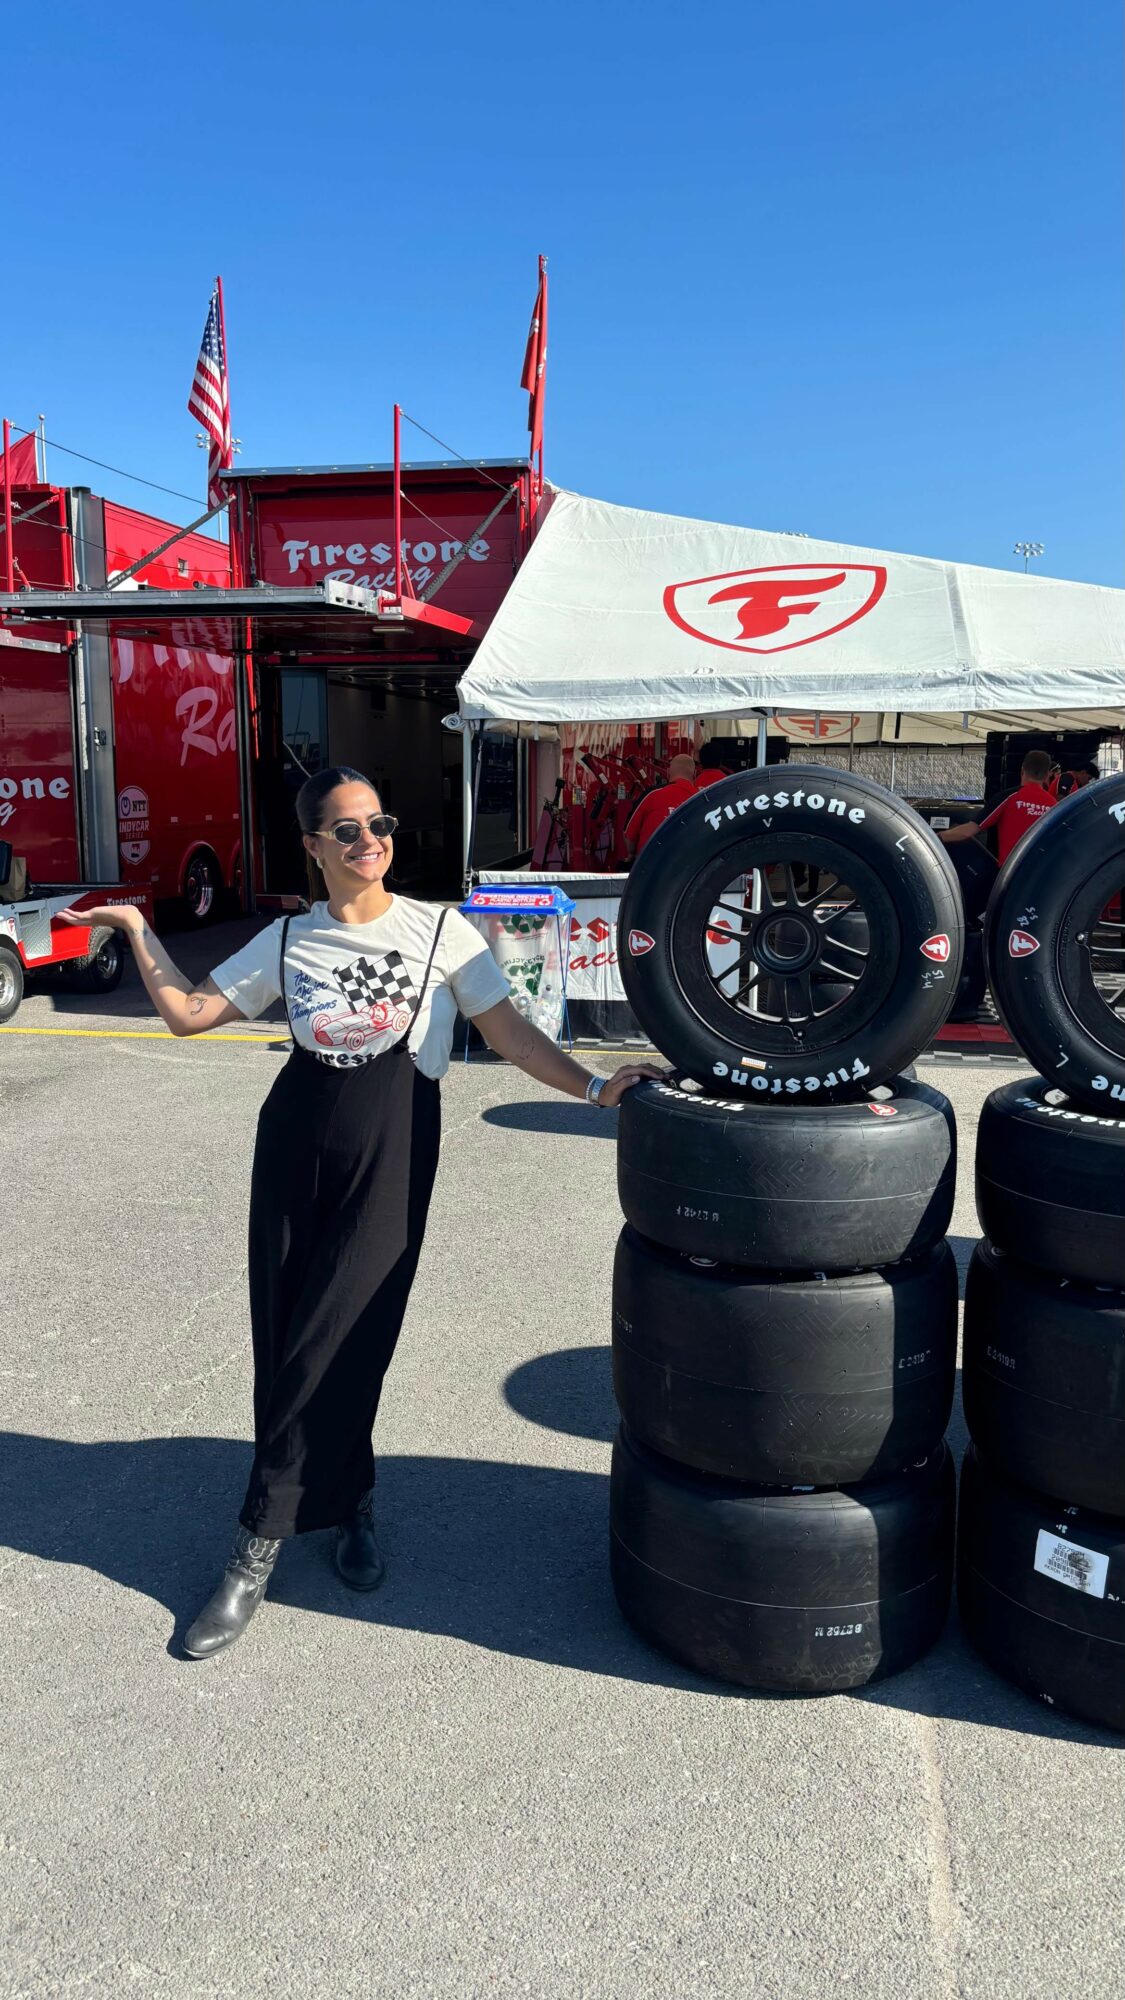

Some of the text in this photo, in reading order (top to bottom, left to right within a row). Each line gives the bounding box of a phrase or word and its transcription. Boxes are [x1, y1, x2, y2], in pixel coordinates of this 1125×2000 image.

[282, 538, 490, 574] Firestone
[132, 800, 146, 812] NTT
[704, 790, 866, 831] Firestone
[119, 820, 149, 833] INDYCAR
[294, 970, 311, 987] The
[293, 981, 330, 1001] Choice
[291, 1000, 337, 1022] Champions
[712, 1057, 871, 1094] Firestone
